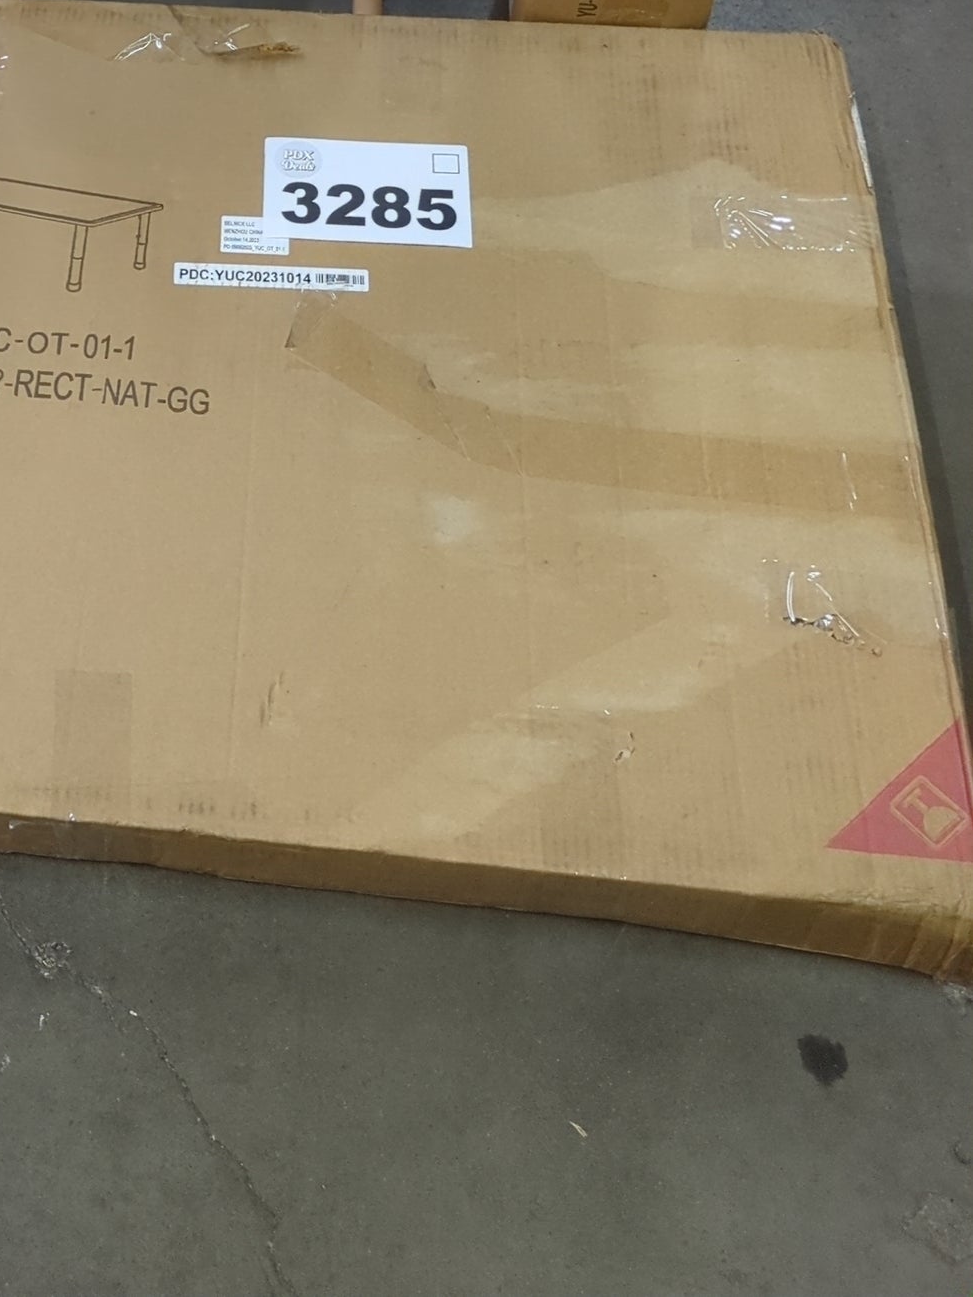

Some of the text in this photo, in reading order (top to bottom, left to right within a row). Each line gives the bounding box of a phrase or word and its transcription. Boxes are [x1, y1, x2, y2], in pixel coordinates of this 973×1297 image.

[283, 149, 315, 161] PDX
[281, 181, 458, 231] 3285
[179, 268, 312, 285] PDC:YUC20231014
